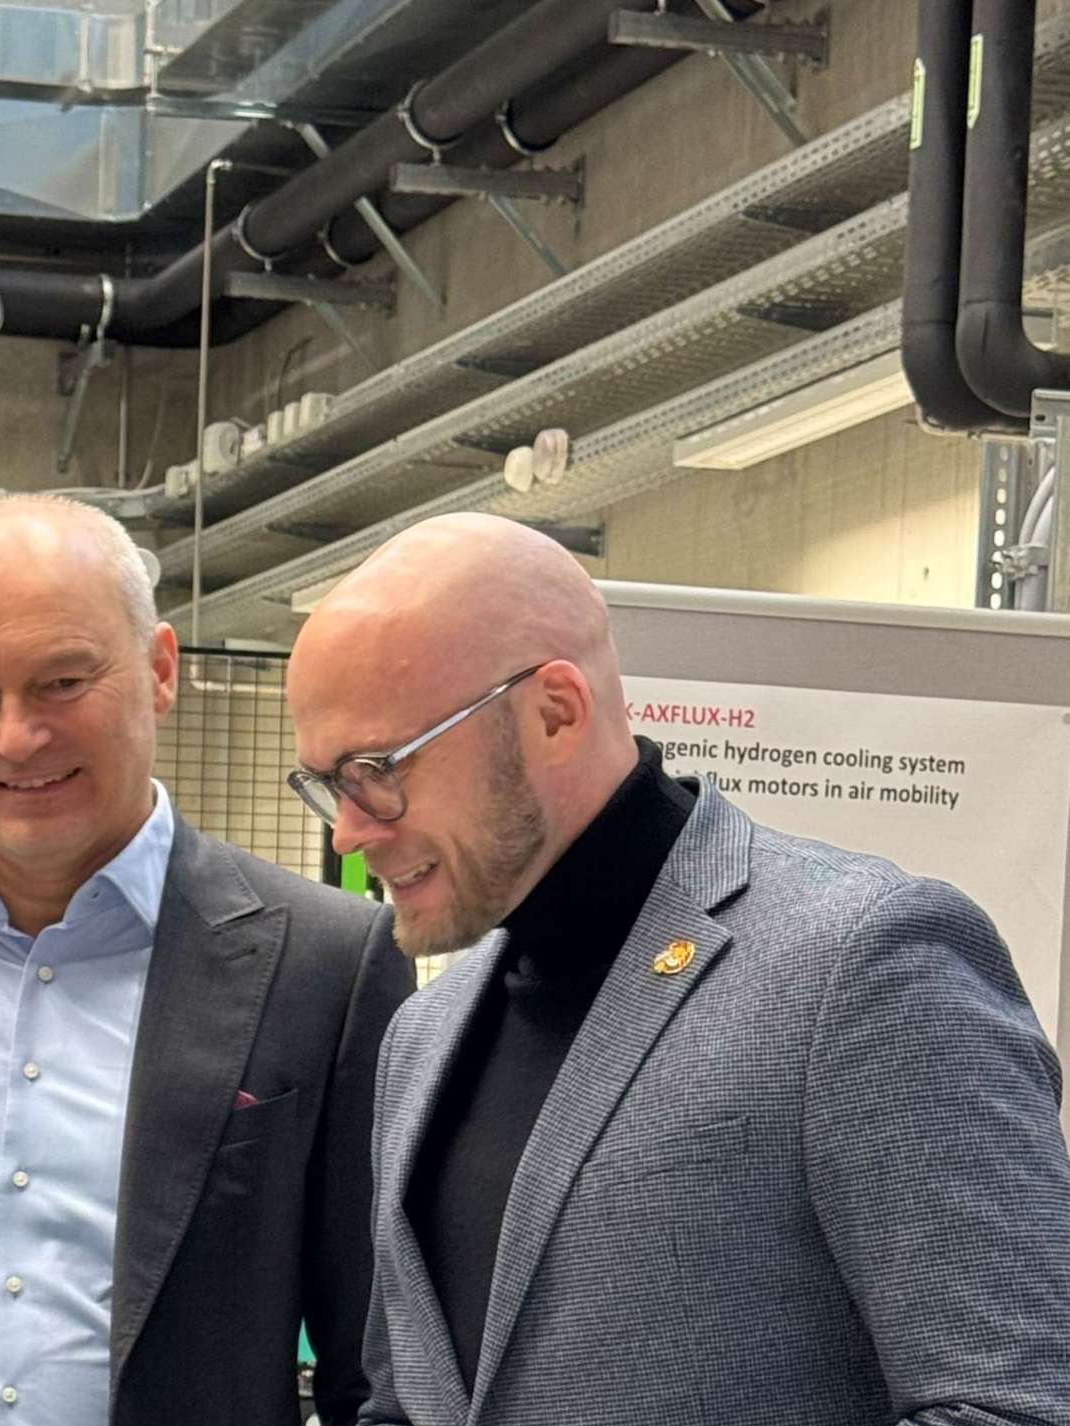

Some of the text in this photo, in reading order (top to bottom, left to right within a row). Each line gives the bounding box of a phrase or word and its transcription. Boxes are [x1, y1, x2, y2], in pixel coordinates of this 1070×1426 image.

[724, 740, 817, 768] hydrogen
[823, 748, 894, 774] cooling
[898, 755, 966, 776] system
[748, 777, 819, 797] motors
[824, 779, 842, 799] in
[848, 781, 875, 800] air
[879, 784, 960, 811] mobility
